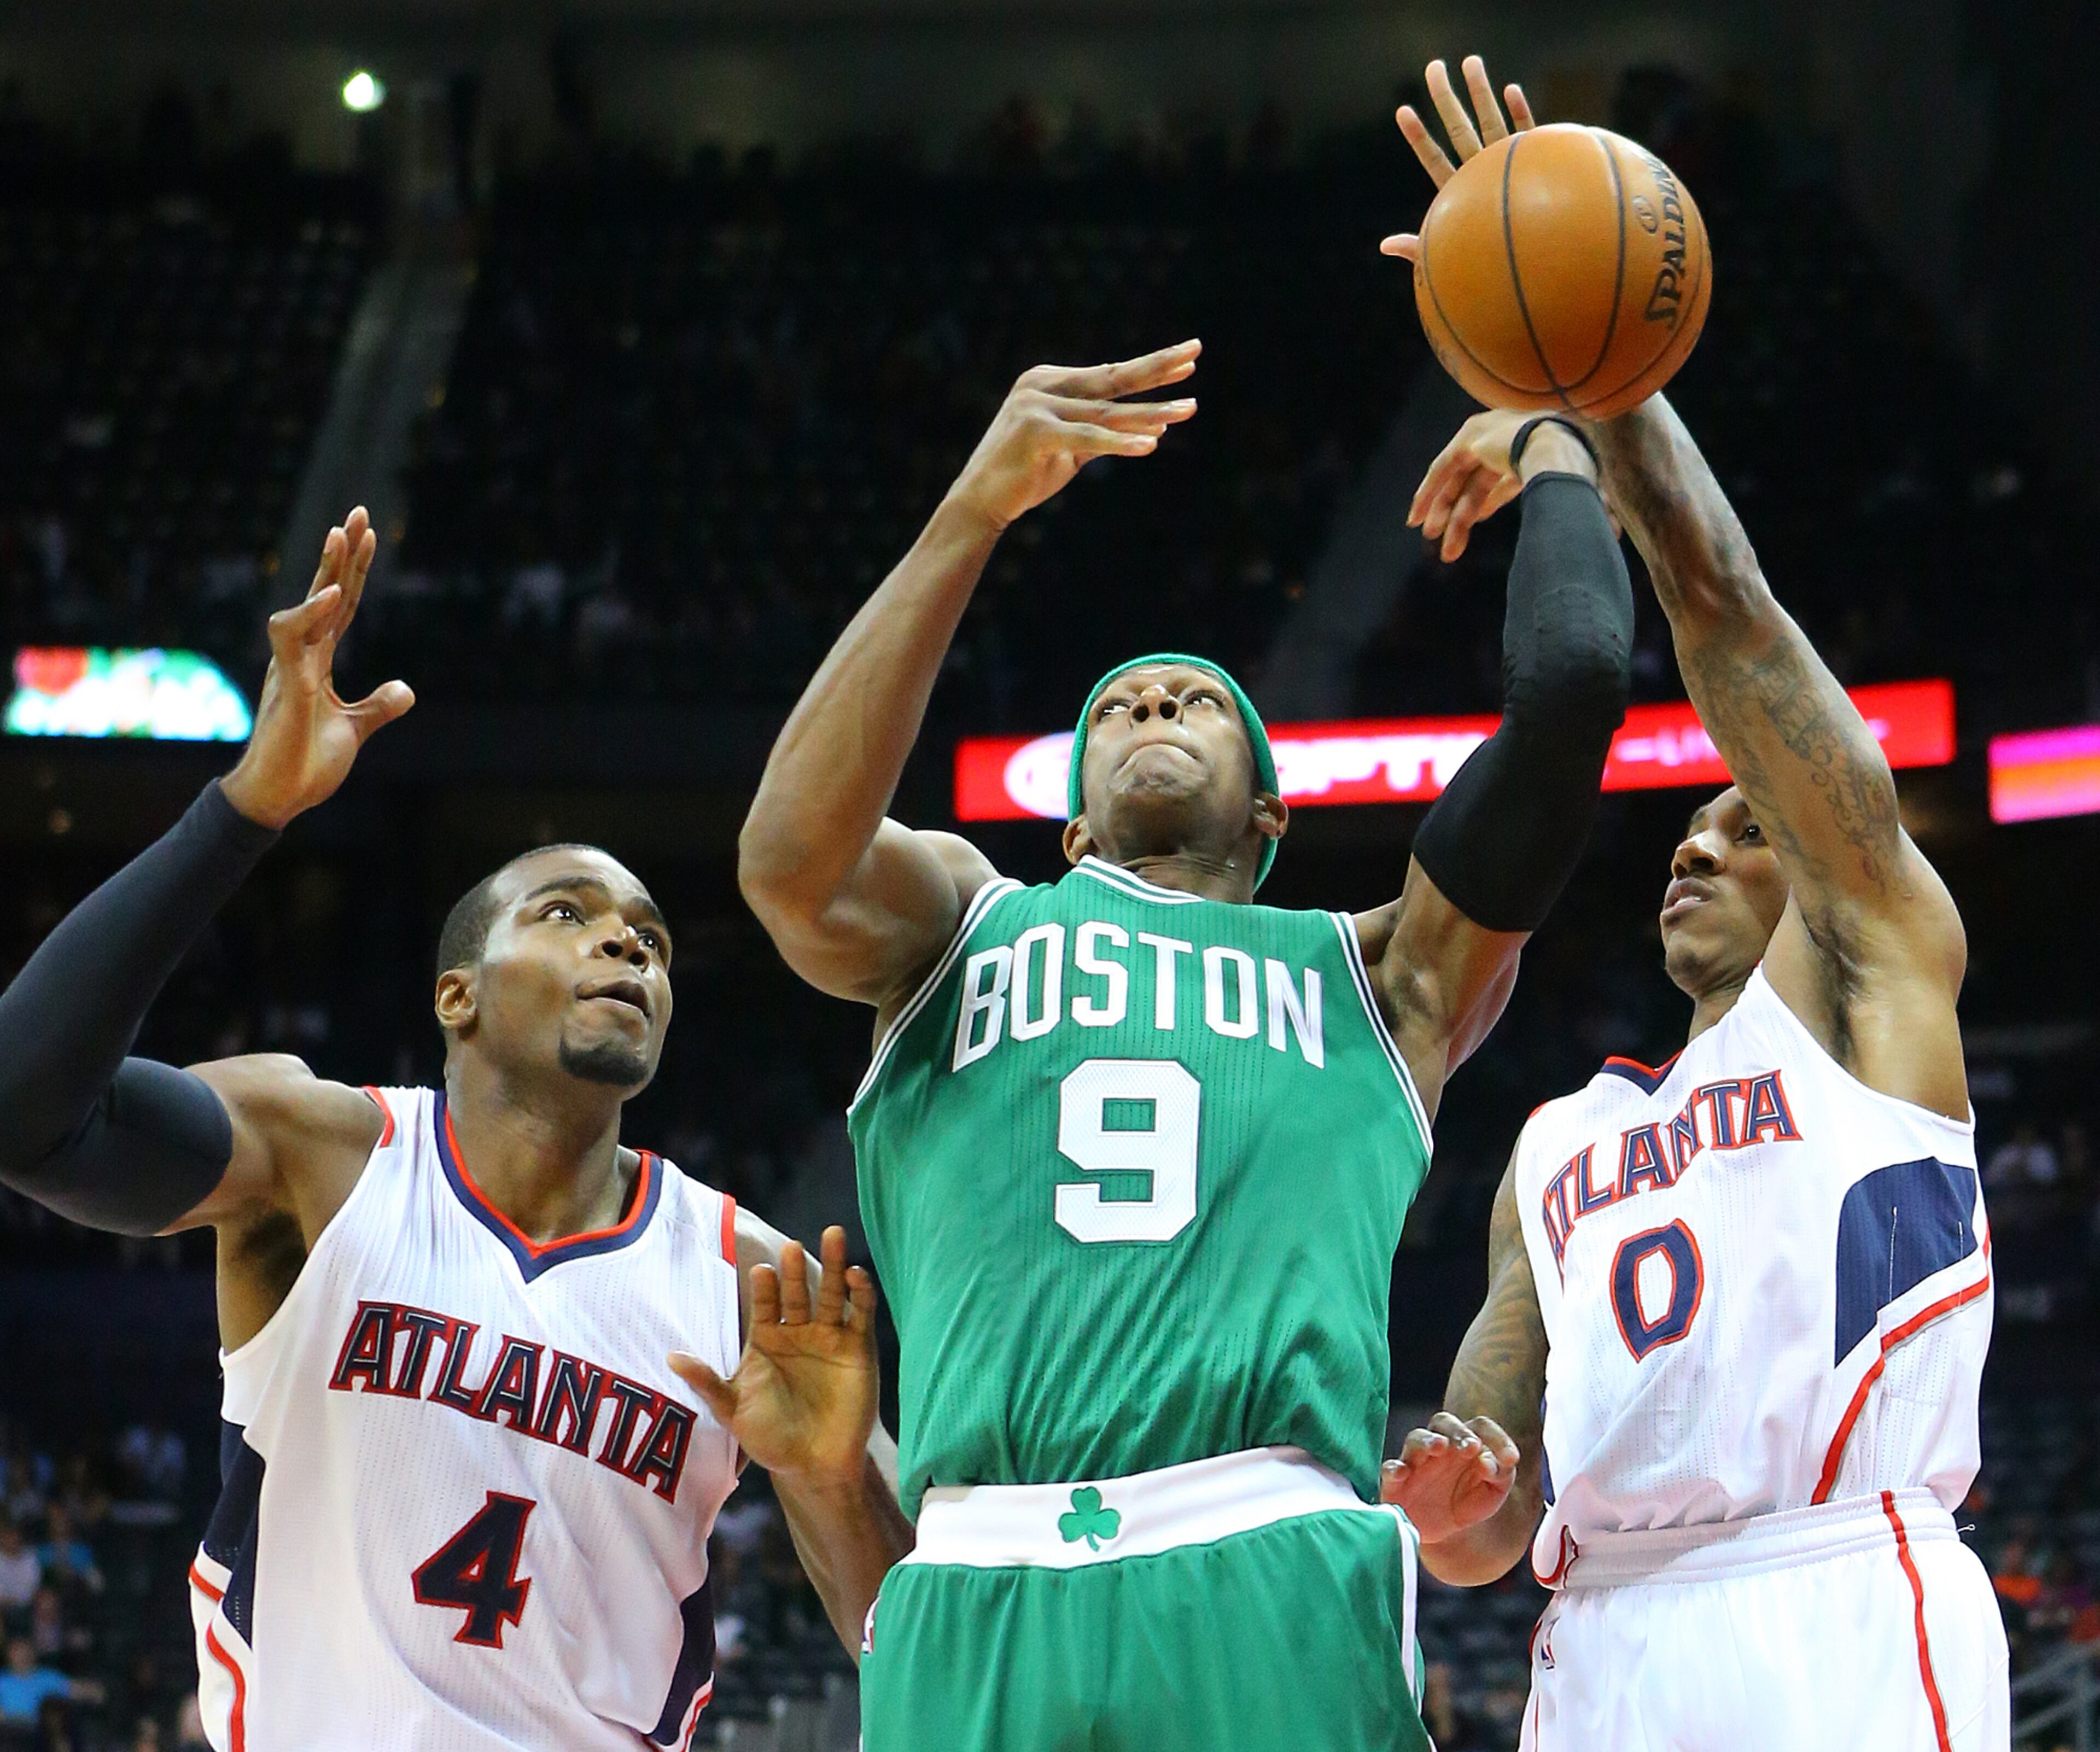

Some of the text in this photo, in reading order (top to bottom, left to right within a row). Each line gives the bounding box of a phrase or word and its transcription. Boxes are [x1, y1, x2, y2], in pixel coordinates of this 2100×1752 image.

[953, 921, 1325, 1073] BOSTON
[1055, 1059, 1201, 1243] 9
[1610, 1219, 1704, 1363] 0
[329, 1301, 698, 1504] ATLANTA
[412, 1491, 536, 1649] 4
